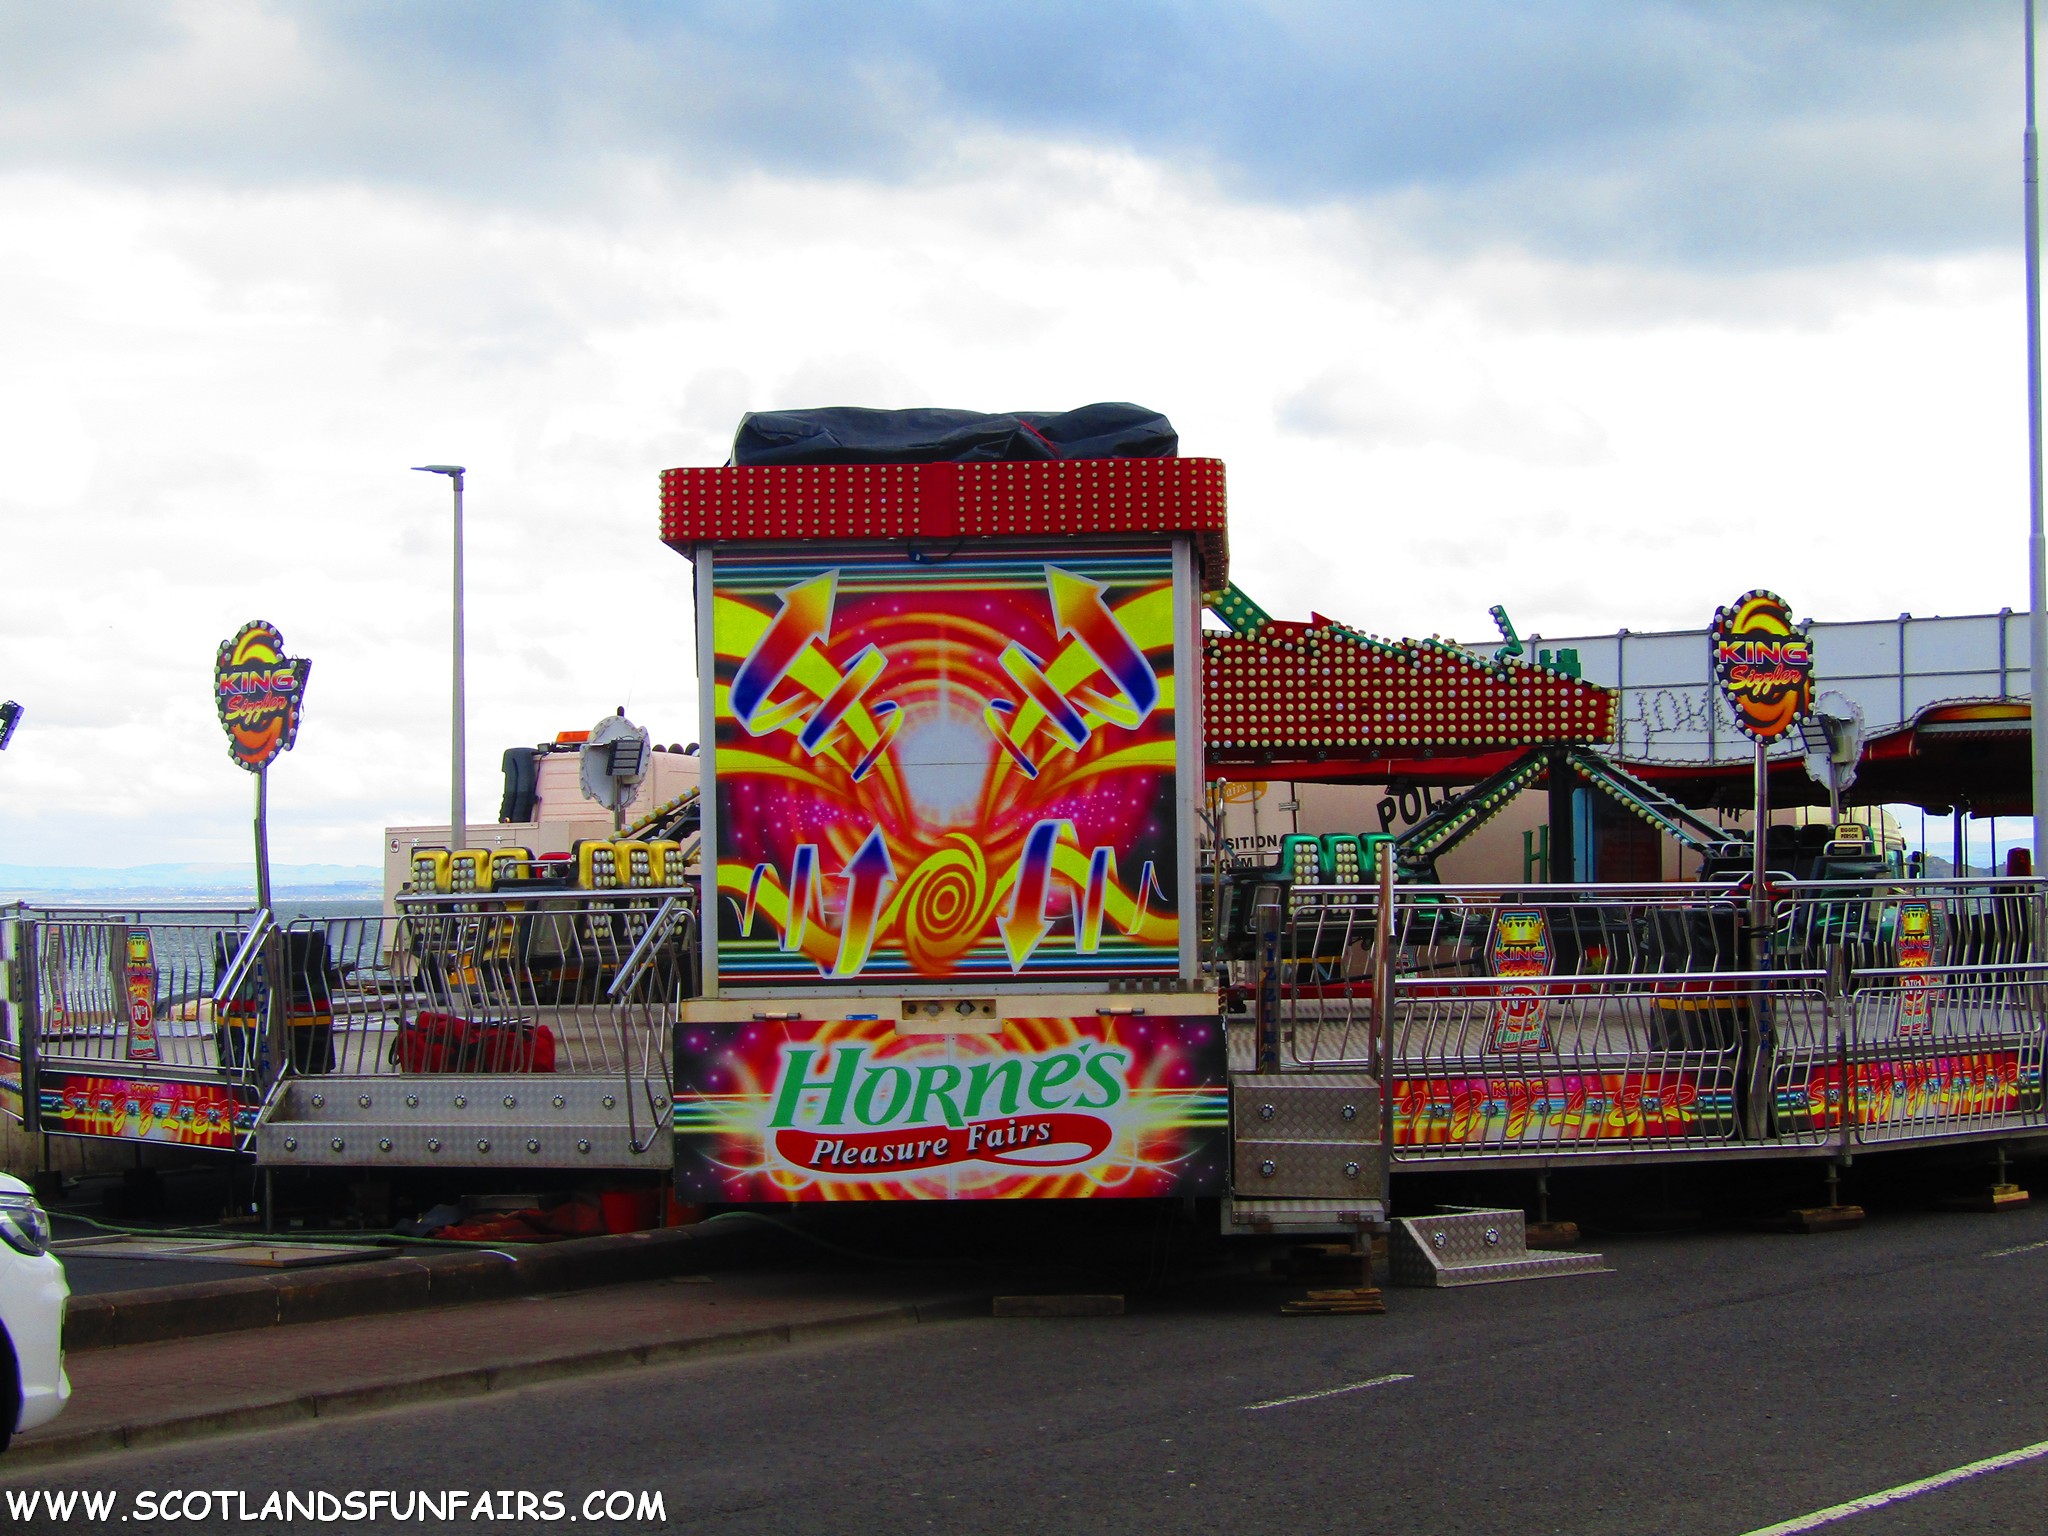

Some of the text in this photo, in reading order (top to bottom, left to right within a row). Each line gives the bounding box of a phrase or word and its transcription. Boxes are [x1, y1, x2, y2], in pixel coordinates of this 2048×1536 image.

[1719, 641, 1808, 665] KING
[219, 668, 296, 695] KING
[1727, 663, 1801, 695] Sizzler
[225, 691, 288, 725] Sizzler
[1217, 782, 1248, 797] airs
[1496, 946, 1547, 960] KING
[1899, 936, 1930, 950] KING
[131, 1083, 160, 1099] KING
[1492, 1080, 1548, 1097] KING
[1400, 1083, 1696, 1139] IZZLER
[809, 1119, 1050, 1165] Pleasure Fairs
